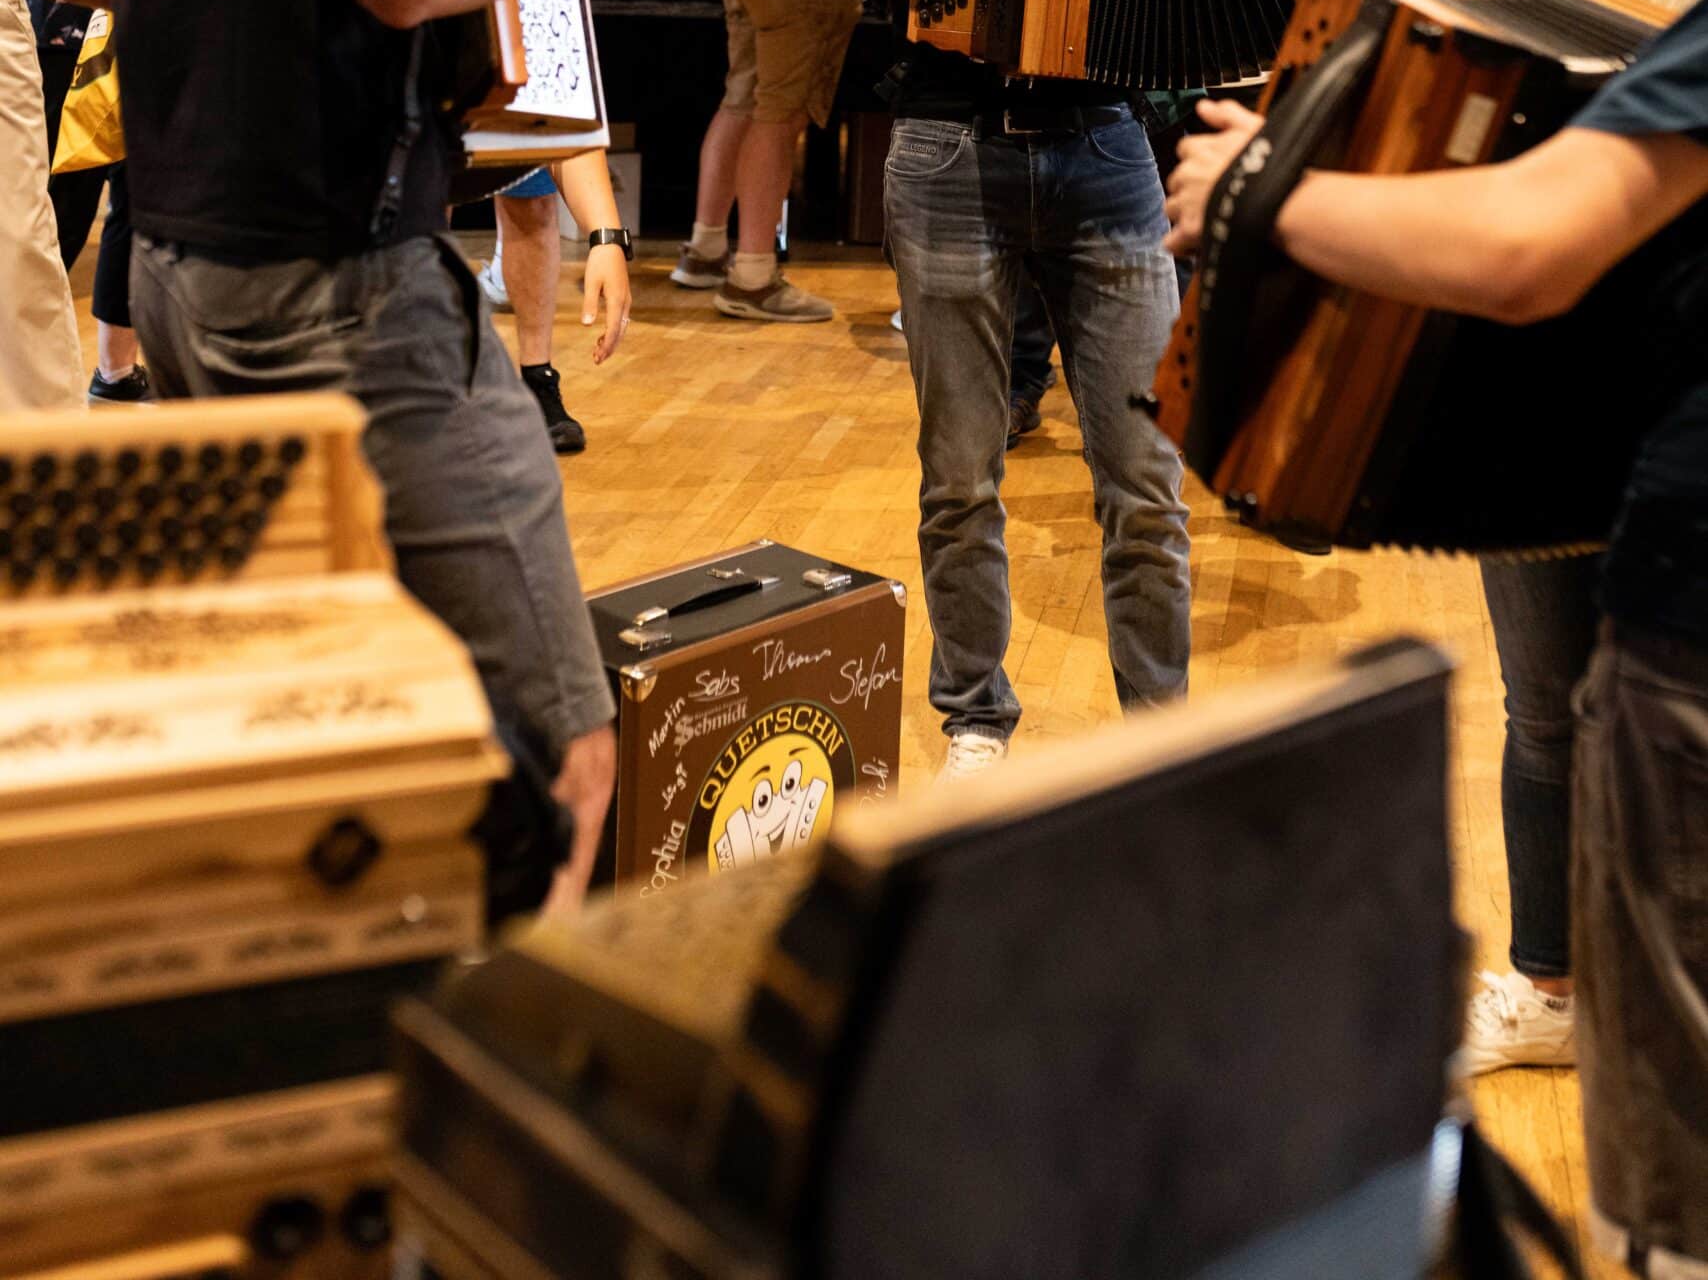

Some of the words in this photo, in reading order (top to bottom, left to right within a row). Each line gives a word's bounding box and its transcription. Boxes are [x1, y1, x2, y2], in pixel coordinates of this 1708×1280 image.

[829, 643, 903, 710] Stefan
[649, 697, 686, 758] Martin
[674, 702, 748, 750] Schmidt
[700, 705, 845, 809] QUETSCHN
